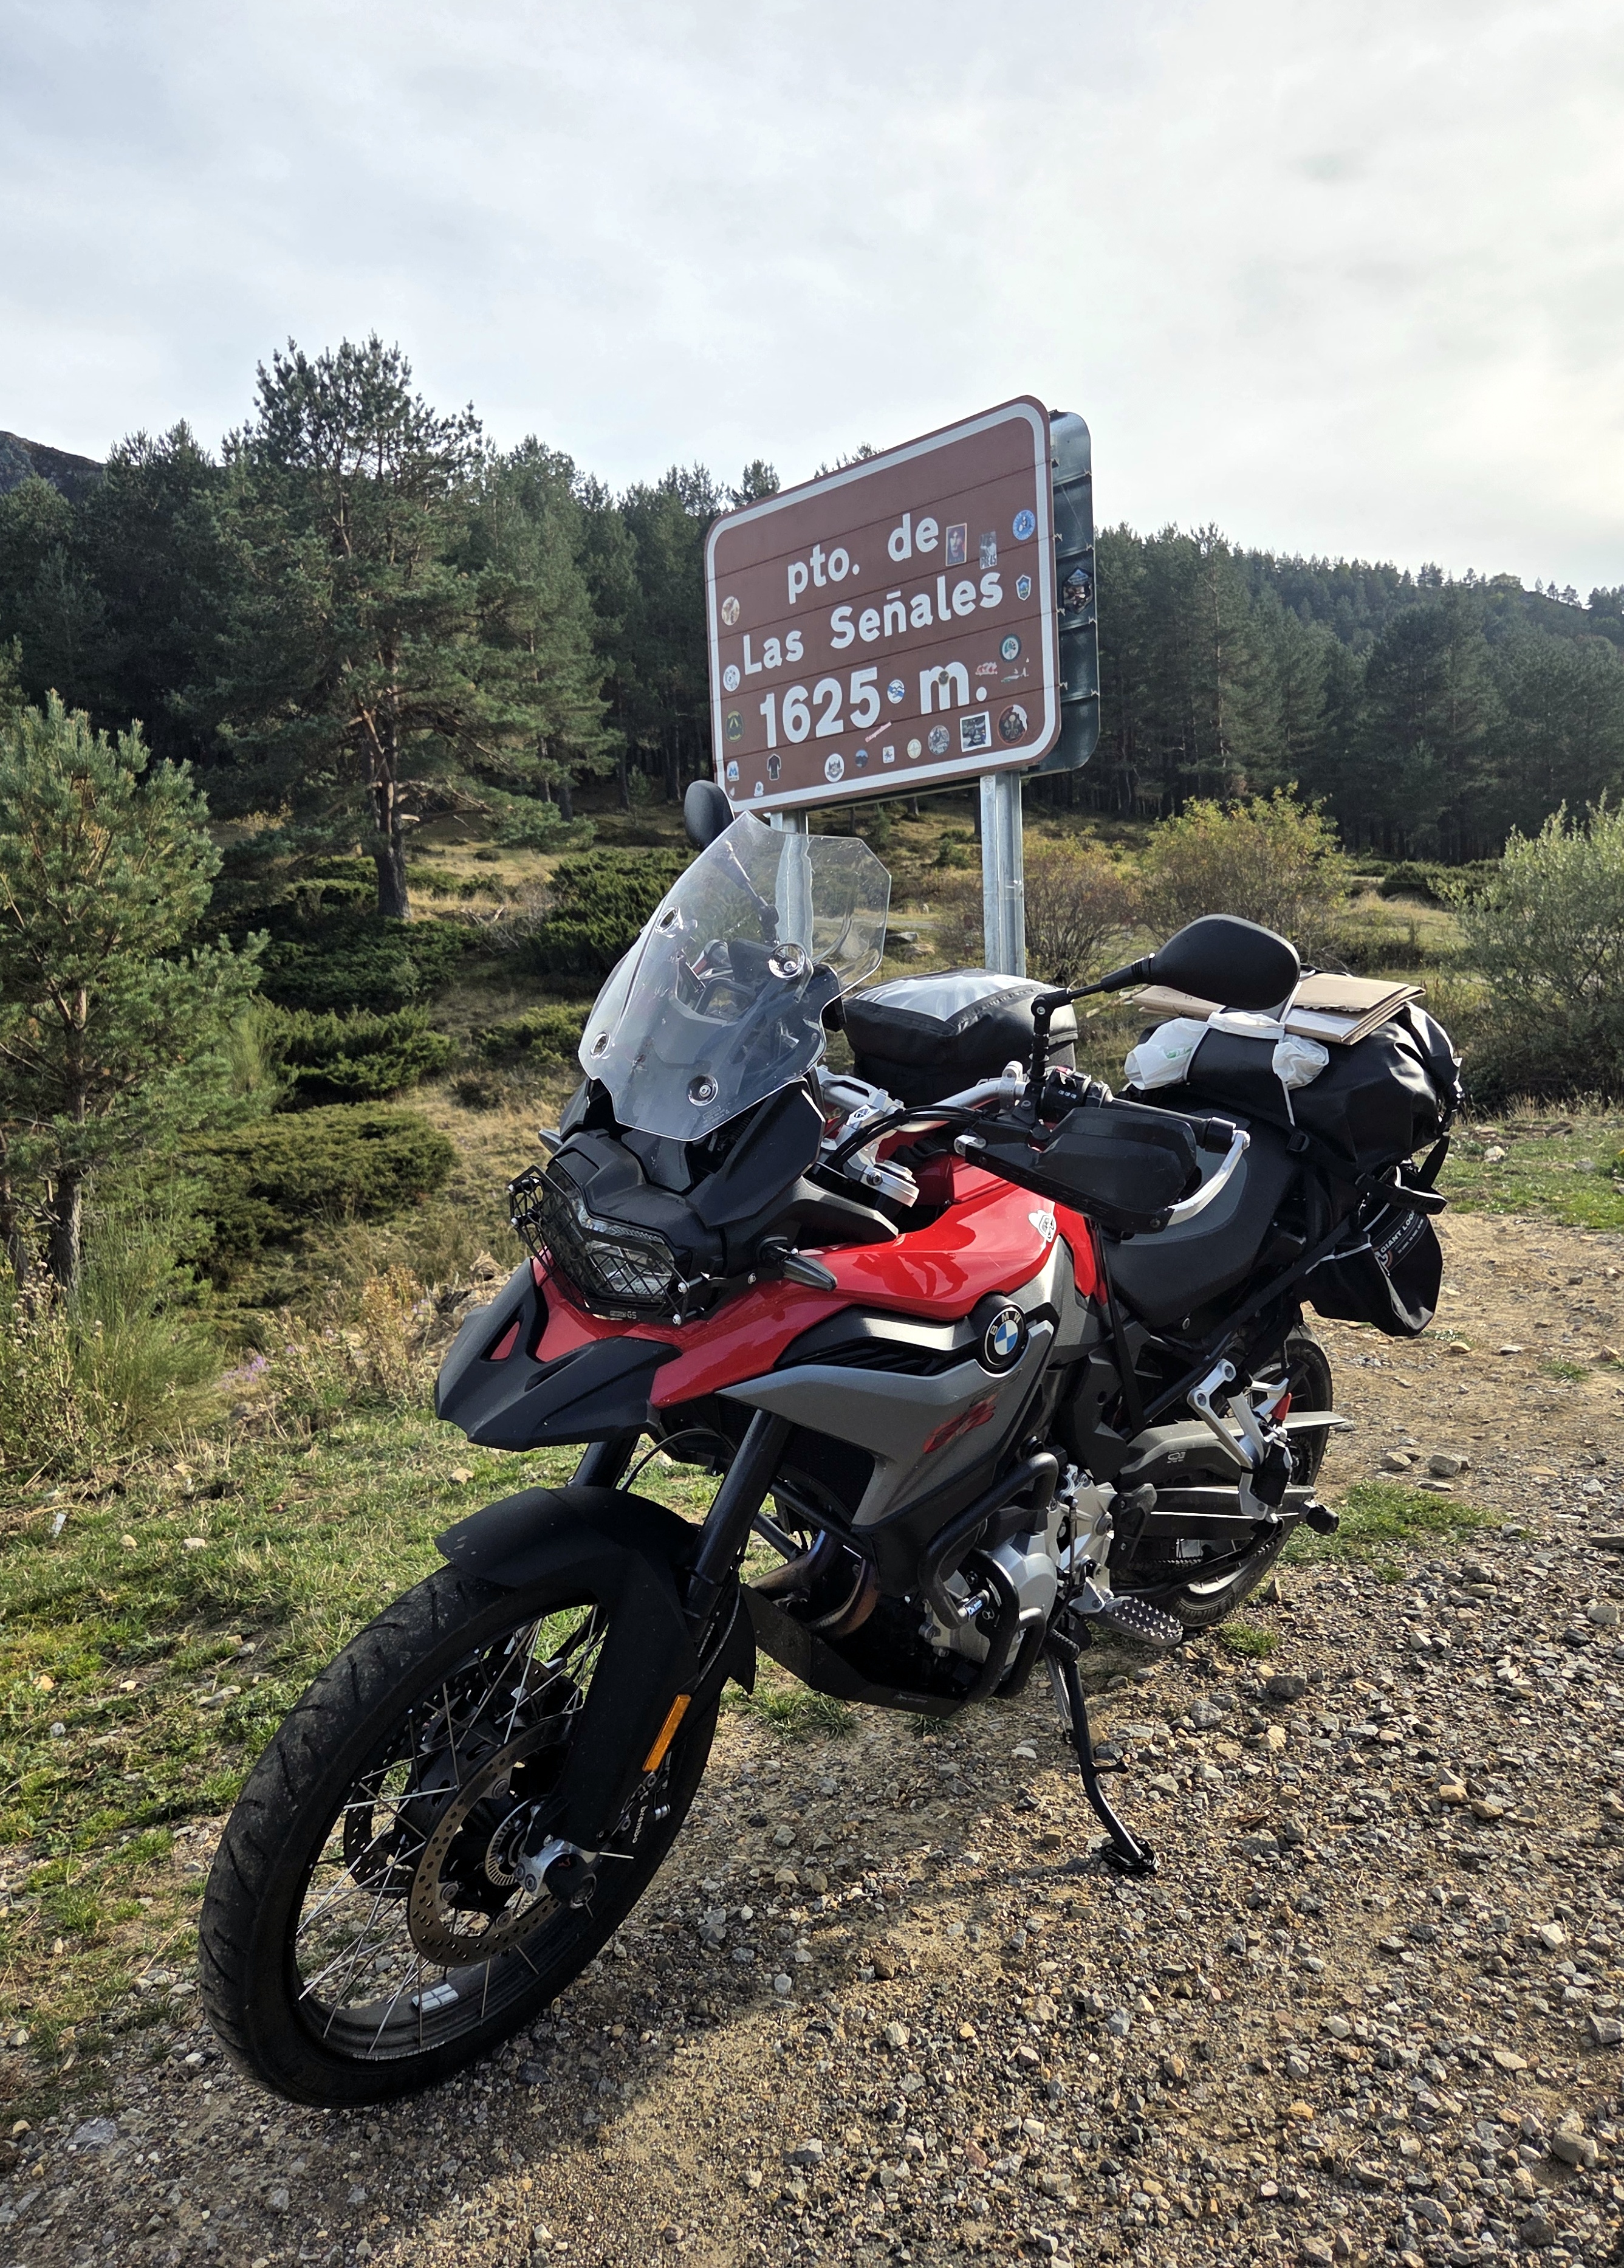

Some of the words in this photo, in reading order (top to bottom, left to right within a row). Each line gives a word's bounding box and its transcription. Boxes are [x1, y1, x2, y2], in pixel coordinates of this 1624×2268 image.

[787, 544, 860, 605] pto.
[888, 513, 939, 562] de
[743, 630, 804, 676] Las
[830, 572, 1003, 649] Señales
[759, 666, 880, 749] 1625
[919, 661, 987, 715] m.
[1380, 1229, 1402, 1253] GIANT
[626, 1310, 637, 1319] GS
[989, 1311, 1021, 1336] BMW
[632, 1804, 649, 1844] brembo
